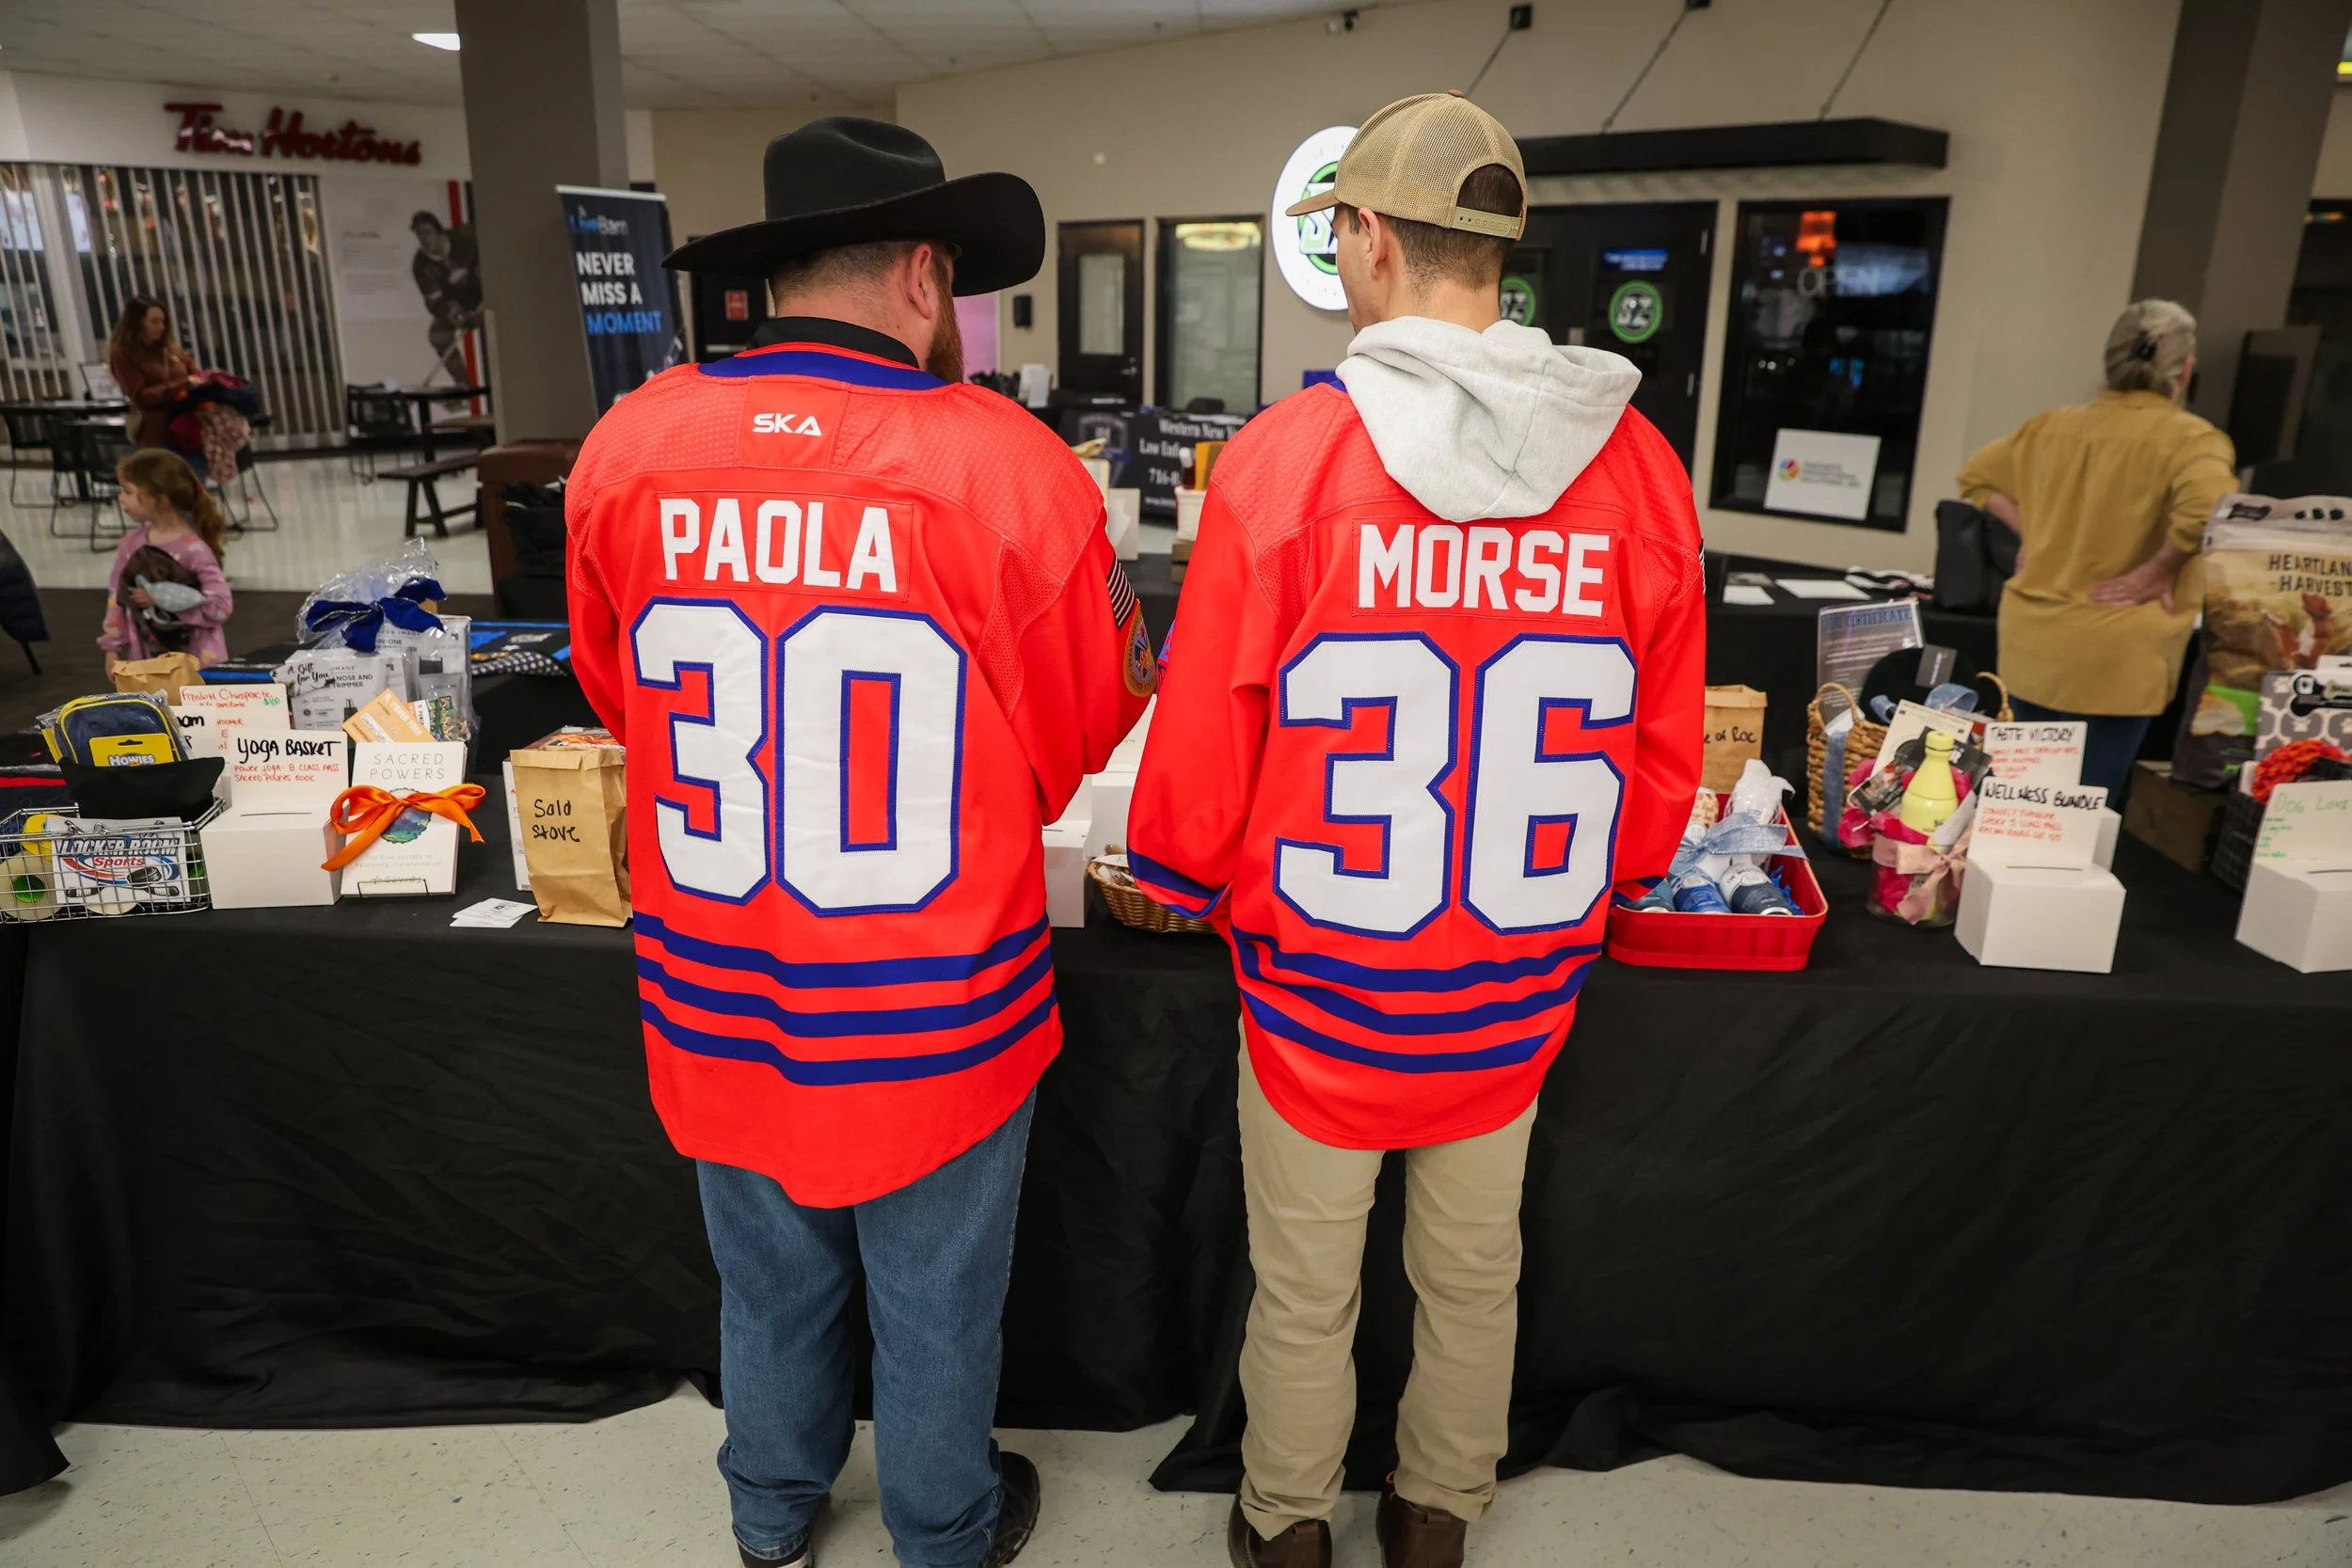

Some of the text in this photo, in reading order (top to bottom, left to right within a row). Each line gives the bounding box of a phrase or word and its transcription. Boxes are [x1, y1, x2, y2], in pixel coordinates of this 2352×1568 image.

[164, 102, 421, 166] Tim Hortons
[576, 250, 635, 277] NEVER
[580, 280, 644, 307] MISS A
[585, 310, 662, 336] MOMENT
[752, 412, 823, 437] SKA
[660, 498, 898, 593] PAOLA
[1358, 523, 1610, 617] MORSE
[108, 753, 155, 766] HOWIES
[299, 763, 321, 772] CLASS
[373, 752, 444, 766] SACRED
[629, 594, 969, 918] 30
[370, 768, 445, 780] POWERS
[1271, 629, 1639, 942] 36
[1984, 782, 2106, 811] WELLNESS BUNDLE
[60, 837, 180, 856] LOCKER ROOM
[94, 856, 145, 868] Sports
